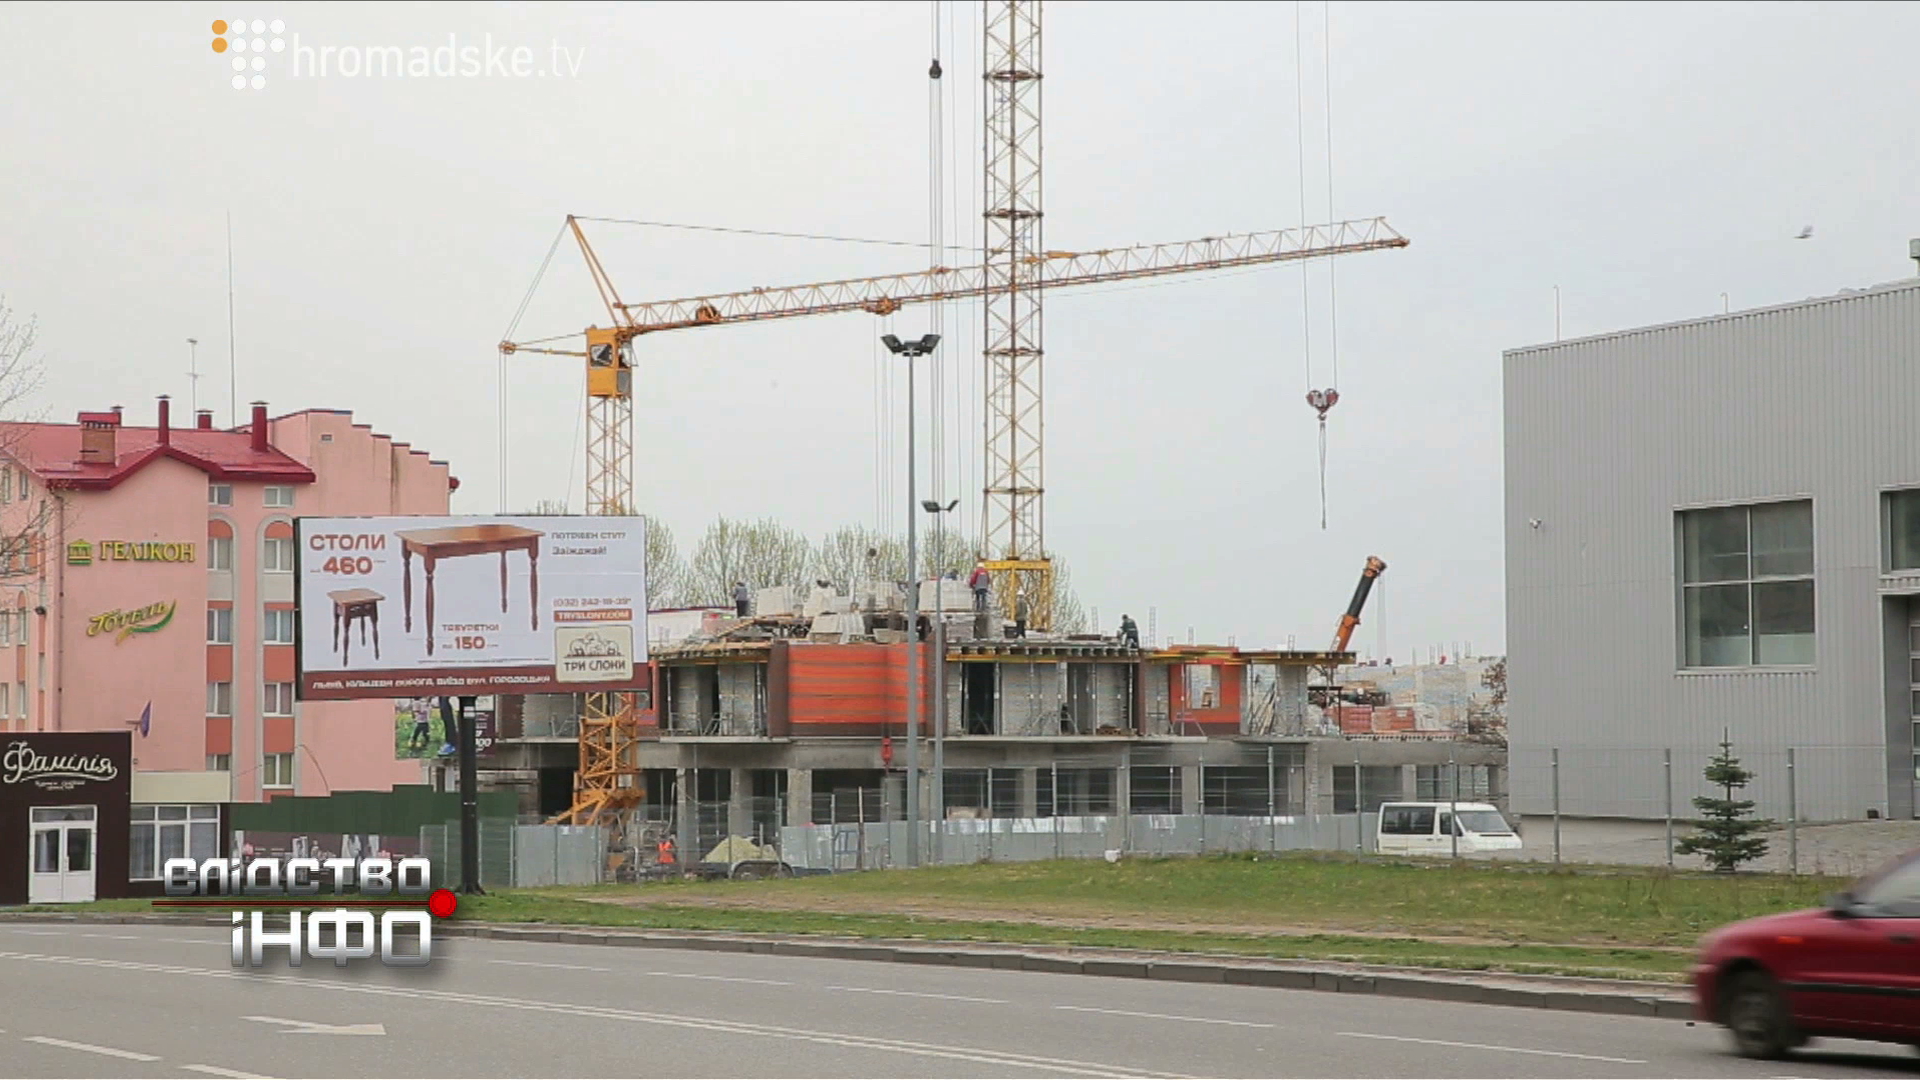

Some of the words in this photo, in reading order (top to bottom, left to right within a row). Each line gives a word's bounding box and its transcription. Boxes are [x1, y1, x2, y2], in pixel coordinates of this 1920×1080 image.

[310, 534, 386, 550] СТОЛИ
[100, 540, 195, 562] ГЕЛІКОН
[323, 556, 373, 575] 460
[455, 636, 485, 649] 150
[564, 662, 586, 671] ТРИ
[589, 660, 626, 671] СЛОНИ
[3, 741, 118, 783] Фамілія
